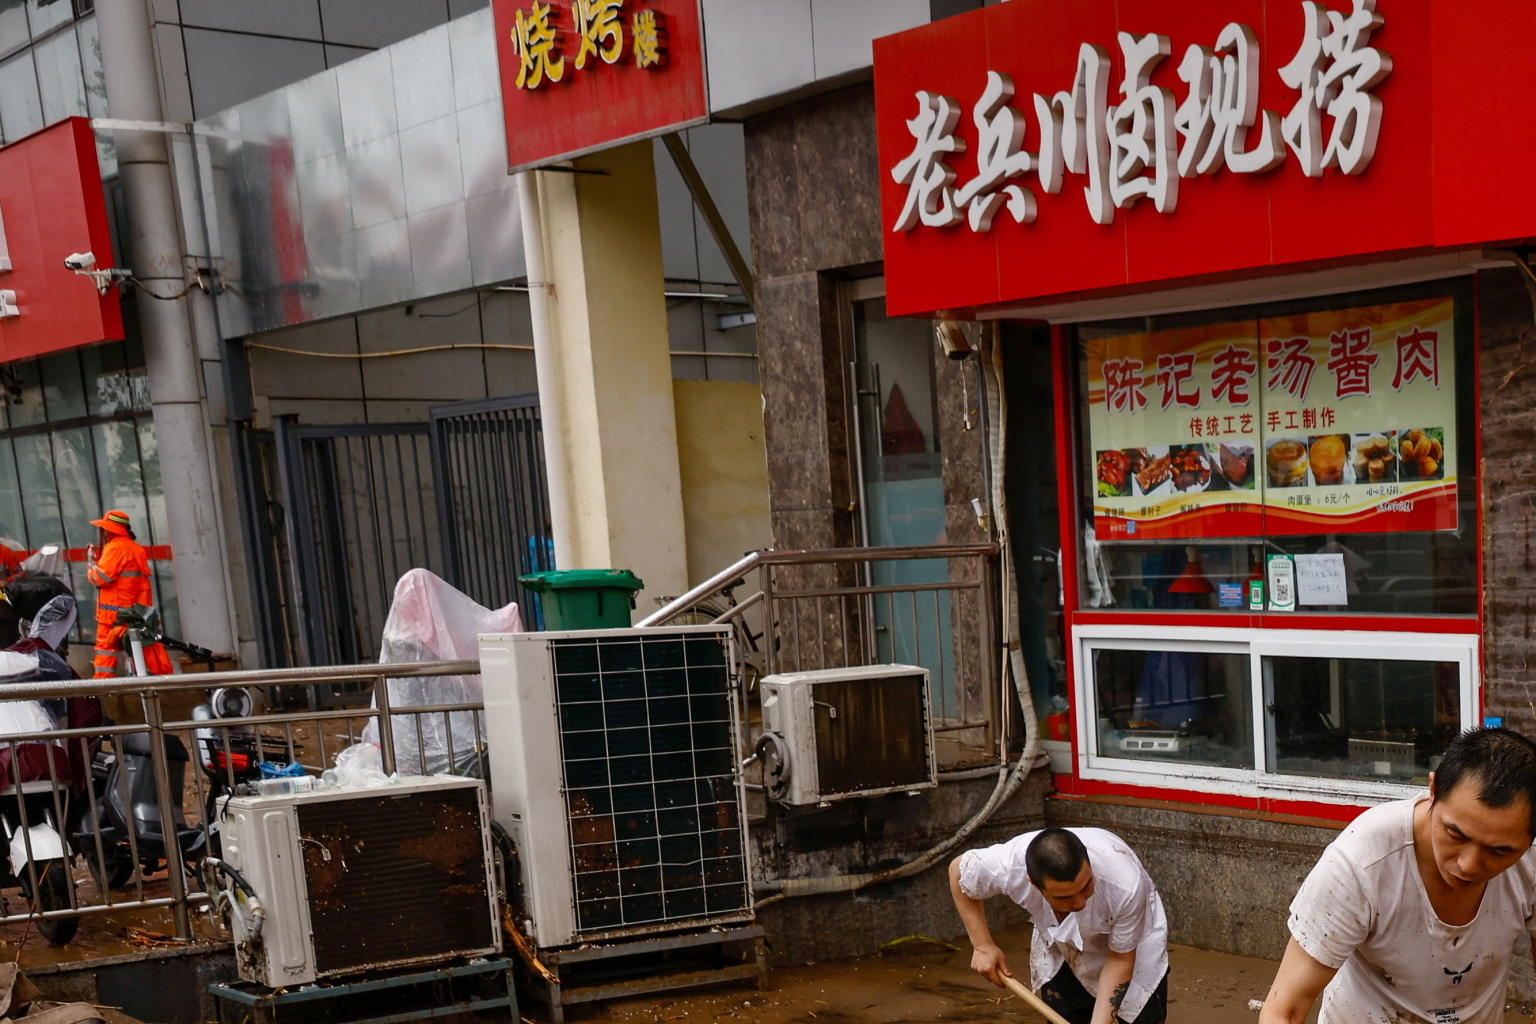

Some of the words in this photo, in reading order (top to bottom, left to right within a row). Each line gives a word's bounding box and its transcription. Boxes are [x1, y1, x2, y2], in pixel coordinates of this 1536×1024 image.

[1103, 325, 1441, 412] 陈记老汤酱肉
[1190, 413, 1254, 437] 传统工艺
[1267, 406, 1336, 430] 手工制作
